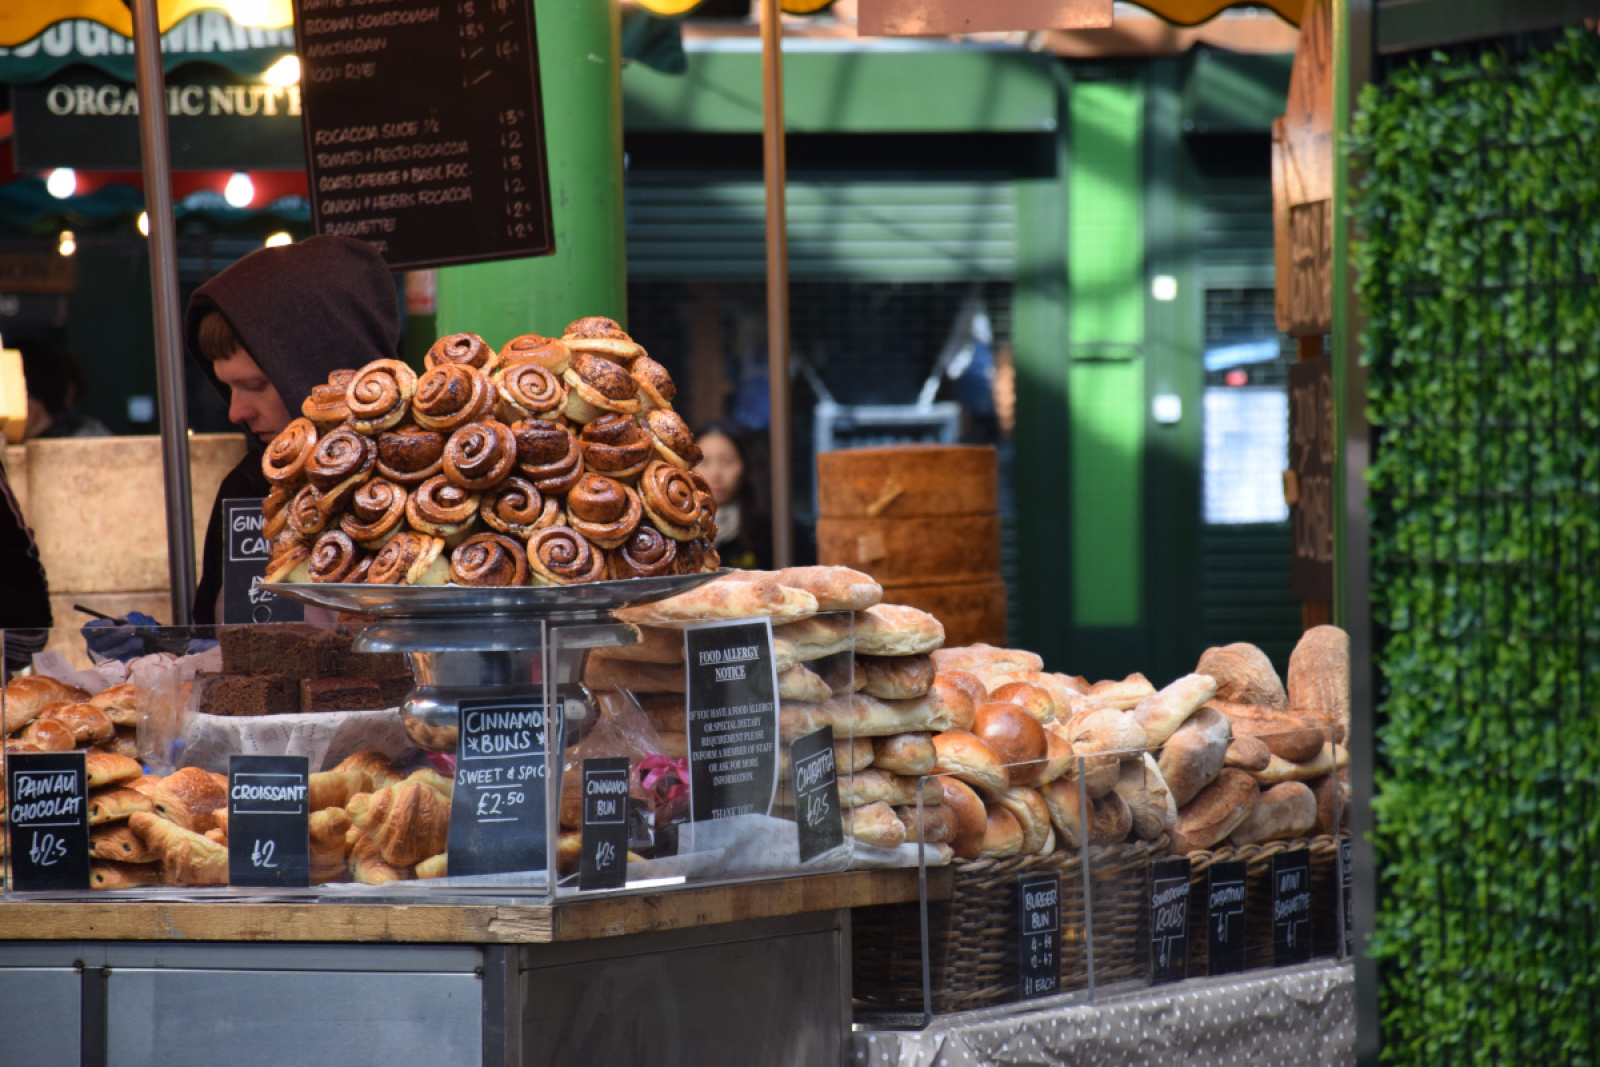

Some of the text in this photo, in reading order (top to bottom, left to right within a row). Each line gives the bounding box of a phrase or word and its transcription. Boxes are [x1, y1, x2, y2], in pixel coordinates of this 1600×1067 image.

[47, 84, 204, 116] ORGAIC
[315, 124, 379, 145] FOCACCIA
[381, 120, 419, 139] SLICE
[411, 140, 469, 160] FOCACCIA
[354, 169, 401, 189] CHEESE
[417, 185, 472, 205] FOCACCIA
[324, 217, 397, 237] BAGUETTE
[233, 514, 266, 533] GIN
[240, 537, 271, 555] CA
[699, 646, 760, 664] FOOD ALLERGY
[715, 665, 746, 680] NOTICE
[697, 710, 711, 719] YOU
[711, 708, 727, 718] HAVE
[733, 705, 748, 716] FOOD
[750, 702, 774, 713] ALLERGY
[713, 719, 738, 731] SPECIAL
[738, 717, 761, 729] DIETARY
[701, 730, 765, 747] REQUIREMENT PLEASE
[692, 748, 717, 761] INFORM
[723, 745, 747, 757] MEMBER
[747, 744, 756, 754] OF
[756, 742, 773, 753] STAFF
[709, 758, 759, 773] OR ASK FOR MORE
[459, 766, 503, 785] SWEET
[17, 774, 76, 800] PAIN AU
[231, 784, 307, 802] CROISSANT
[586, 779, 627, 795] CINNAMON
[11, 796, 83, 823] CHOCOLAT
[476, 791, 525, 816] £2.50
[596, 800, 616, 817] BUN
[251, 838, 279, 868] £2
[1025, 889, 1058, 911] BURGER
[1274, 892, 1311, 921] BAGUETTE
[1031, 911, 1049, 929] BUN
[1156, 902, 1184, 933] ROLLS
[1036, 975, 1056, 992] EACH
